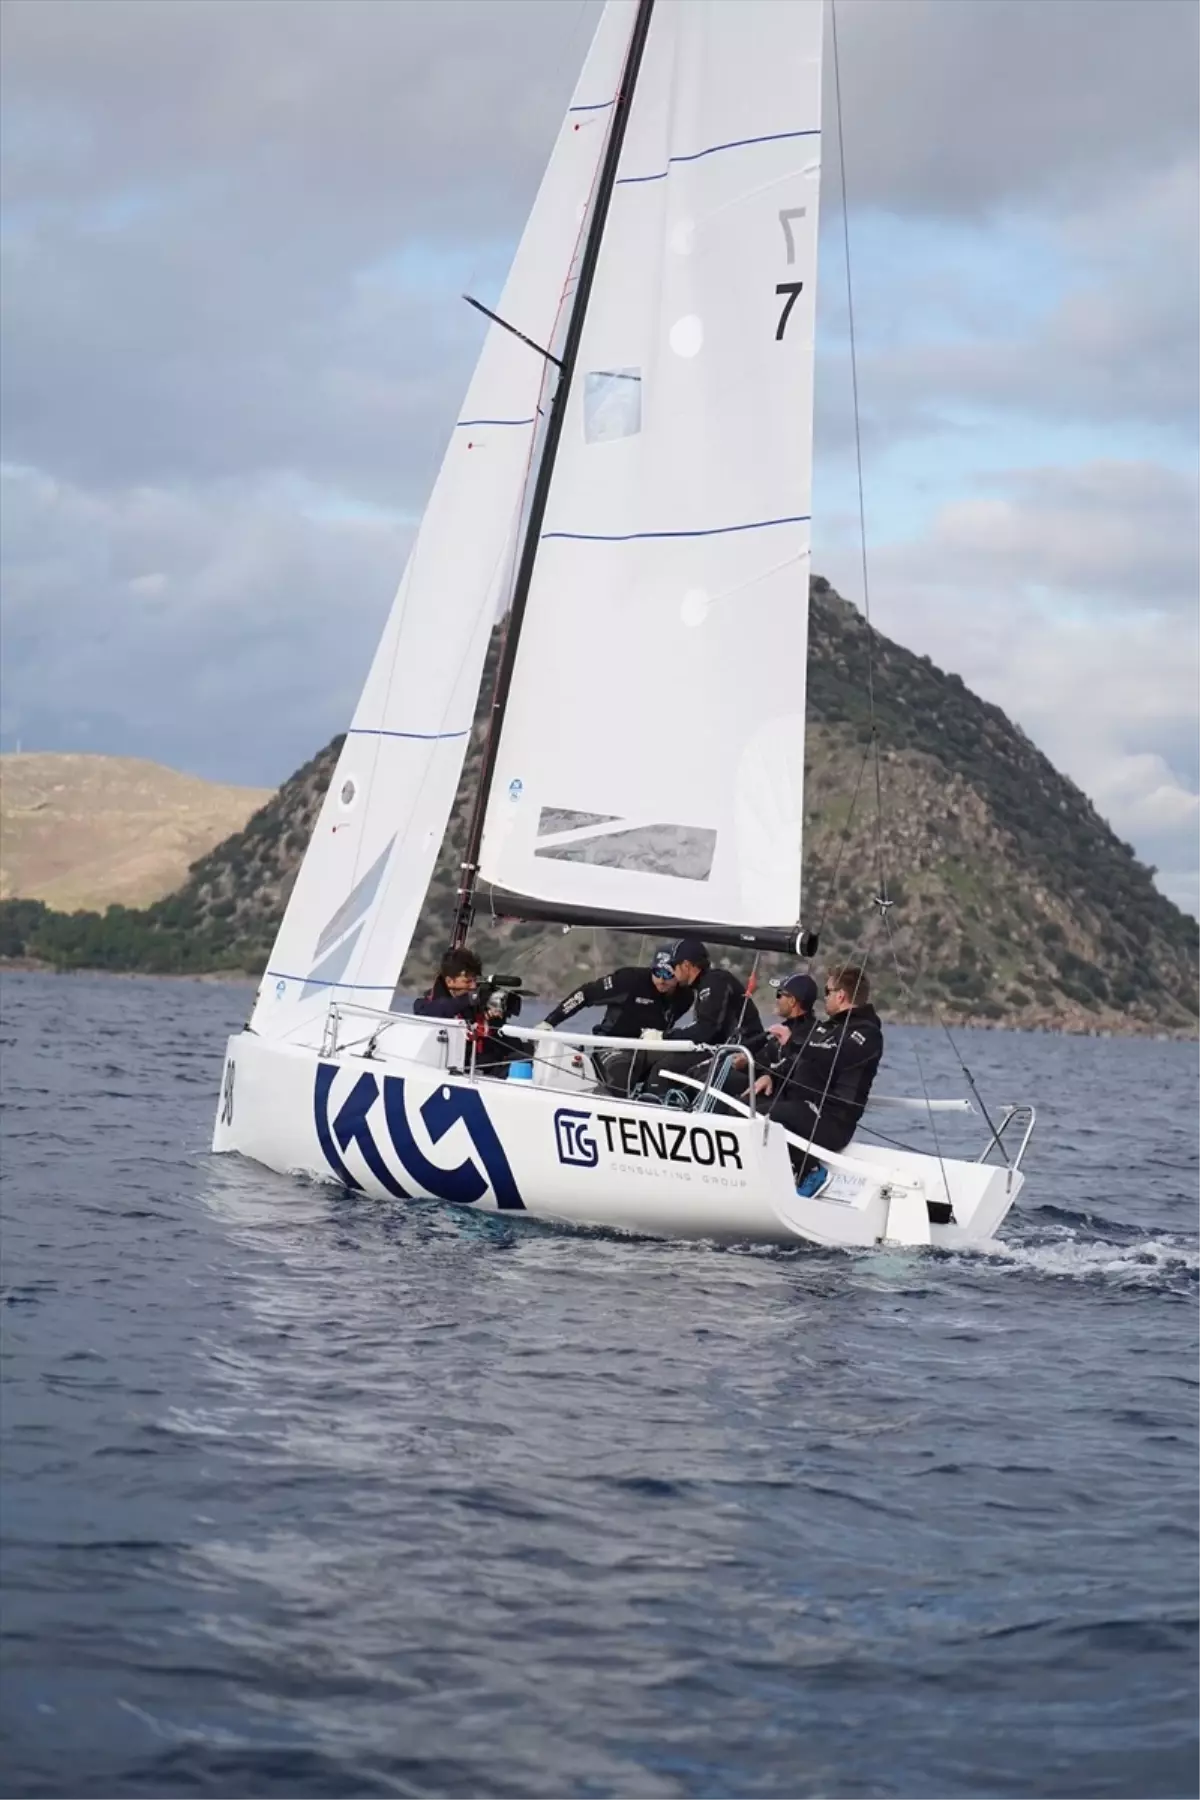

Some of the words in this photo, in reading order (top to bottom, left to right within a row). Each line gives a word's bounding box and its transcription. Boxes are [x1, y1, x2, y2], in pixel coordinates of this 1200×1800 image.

[776, 282, 803, 341] 7
[554, 1108, 599, 1168] TG
[597, 1114, 743, 1170] TENZOR
[610, 1162, 692, 1182] CONSULTING
[702, 1174, 747, 1188] GROUP
